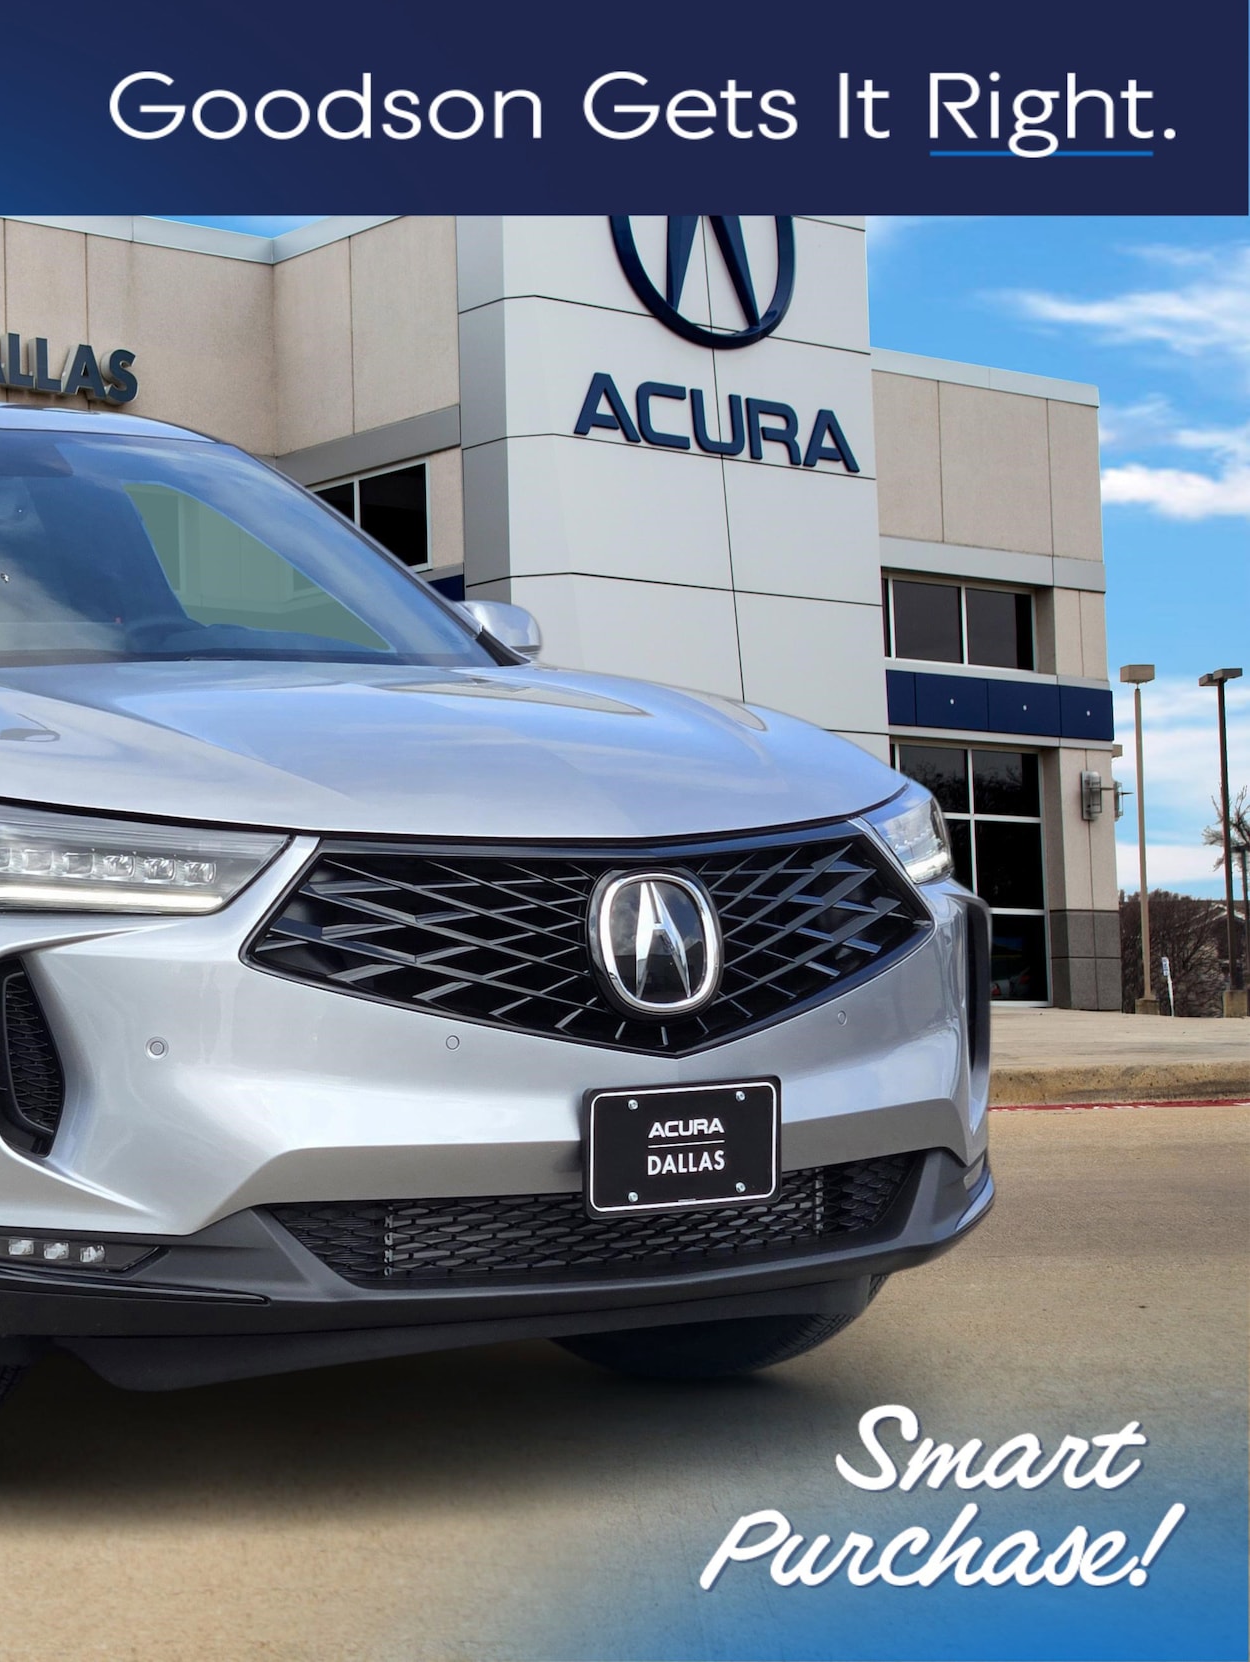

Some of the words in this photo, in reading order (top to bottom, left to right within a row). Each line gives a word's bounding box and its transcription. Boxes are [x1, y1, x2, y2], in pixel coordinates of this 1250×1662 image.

[573, 372, 861, 474] ACURA
[648, 1117, 725, 1139] ACURA
[647, 1150, 726, 1176] DALLAS
